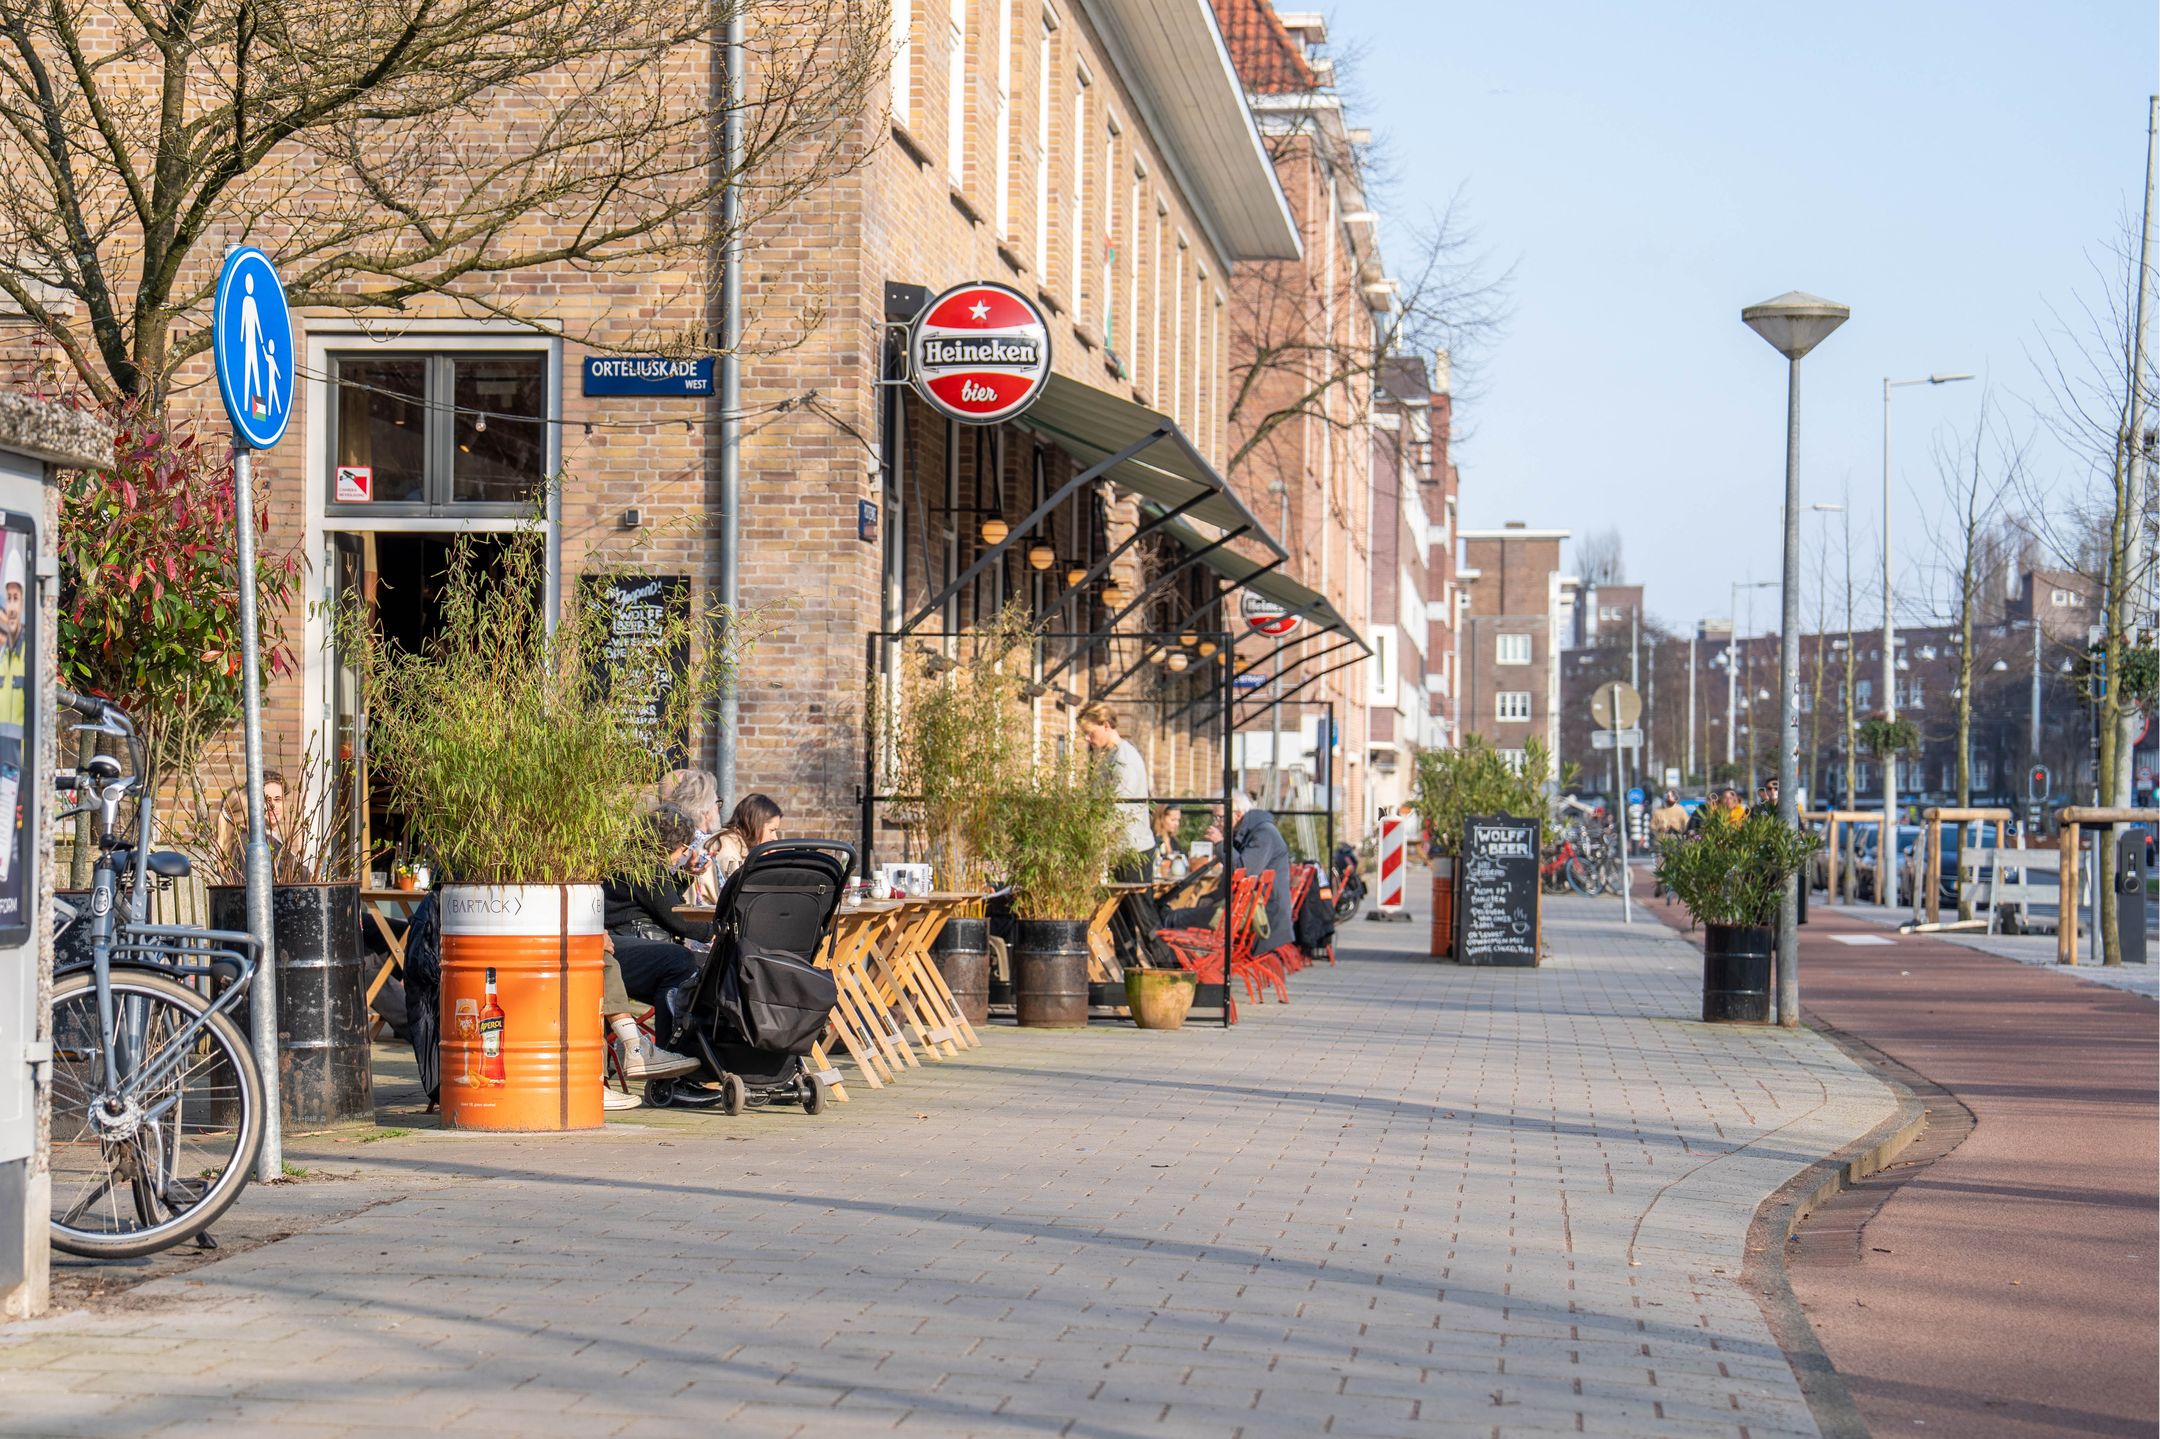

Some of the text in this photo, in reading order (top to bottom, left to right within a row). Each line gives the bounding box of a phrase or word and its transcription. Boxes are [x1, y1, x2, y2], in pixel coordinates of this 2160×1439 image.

[925, 340, 1036, 363] Heineken
[591, 361, 698, 377] ORTELIUSKADE
[685, 380, 707, 389] WEST
[961, 379, 997, 402] bier
[1478, 830, 1526, 842] WOLFF
[1488, 843, 1529, 855] BEER
[452, 899, 511, 914] BARTACK
